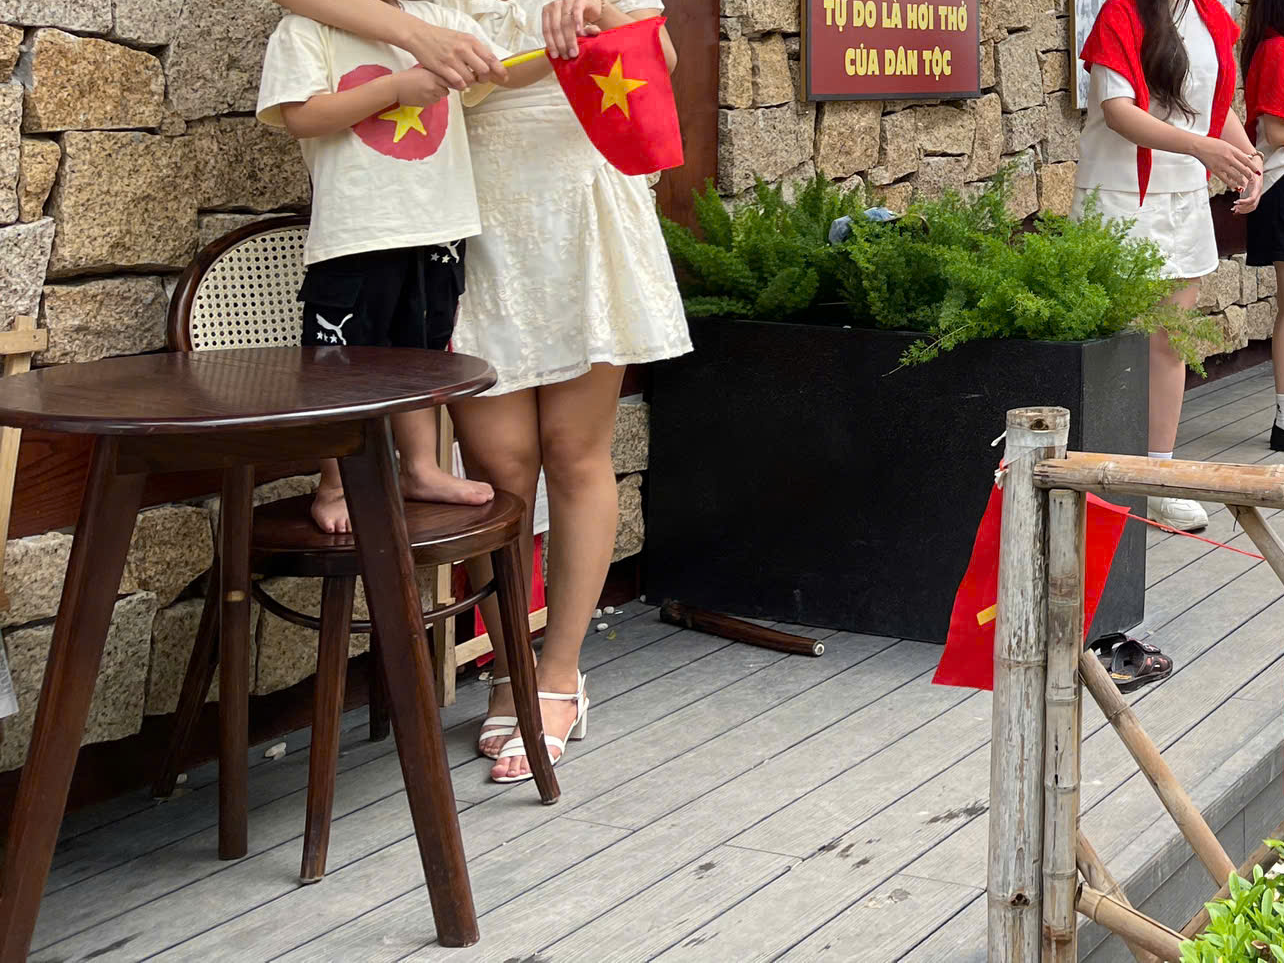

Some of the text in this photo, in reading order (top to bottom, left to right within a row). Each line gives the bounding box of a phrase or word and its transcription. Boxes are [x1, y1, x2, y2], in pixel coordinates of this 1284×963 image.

[852, 0, 877, 28] DO
[907, 1, 934, 30] HƠI
[938, 0, 968, 32] THỞ
[844, 43, 952, 81] CỦA DÂN TỘC
